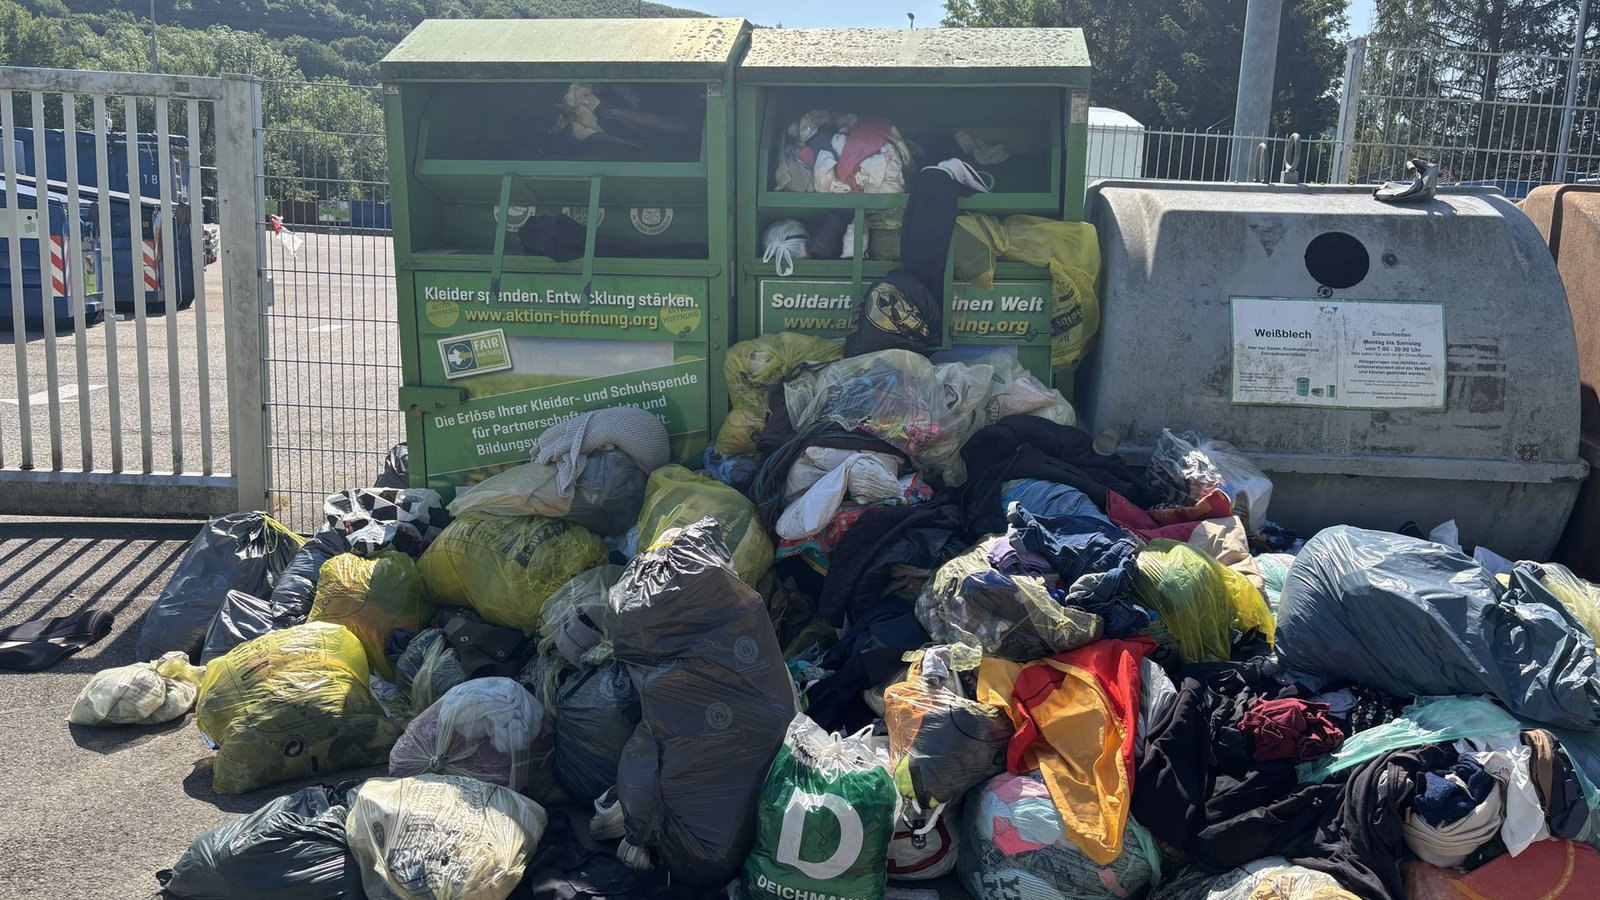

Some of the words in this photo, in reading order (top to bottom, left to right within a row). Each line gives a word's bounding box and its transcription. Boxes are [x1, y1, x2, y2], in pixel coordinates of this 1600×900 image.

[424, 286, 475, 301] Kleider
[546, 290, 635, 309] Entwklung
[639, 292, 698, 307] stärken.
[771, 293, 853, 309] Solidarit
[1001, 296, 1044, 311] Welt
[465, 308, 657, 330] www.aktion-hoffnung.org
[474, 338, 499, 351] FAIR
[1254, 328, 1312, 339] Weißblech
[1396, 340, 1422, 348] Samstag
[434, 416, 455, 429] Die
[457, 409, 496, 425] Erlöse
[498, 404, 528, 417] Ihrer
[530, 395, 580, 412] Kleider-
[587, 387, 608, 404] und
[611, 373, 698, 399] Schuhspende
[472, 427, 491, 439] für
[642, 395, 667, 410] und
[777, 787, 864, 880] D
[757, 875, 867, 900] DEICHM
